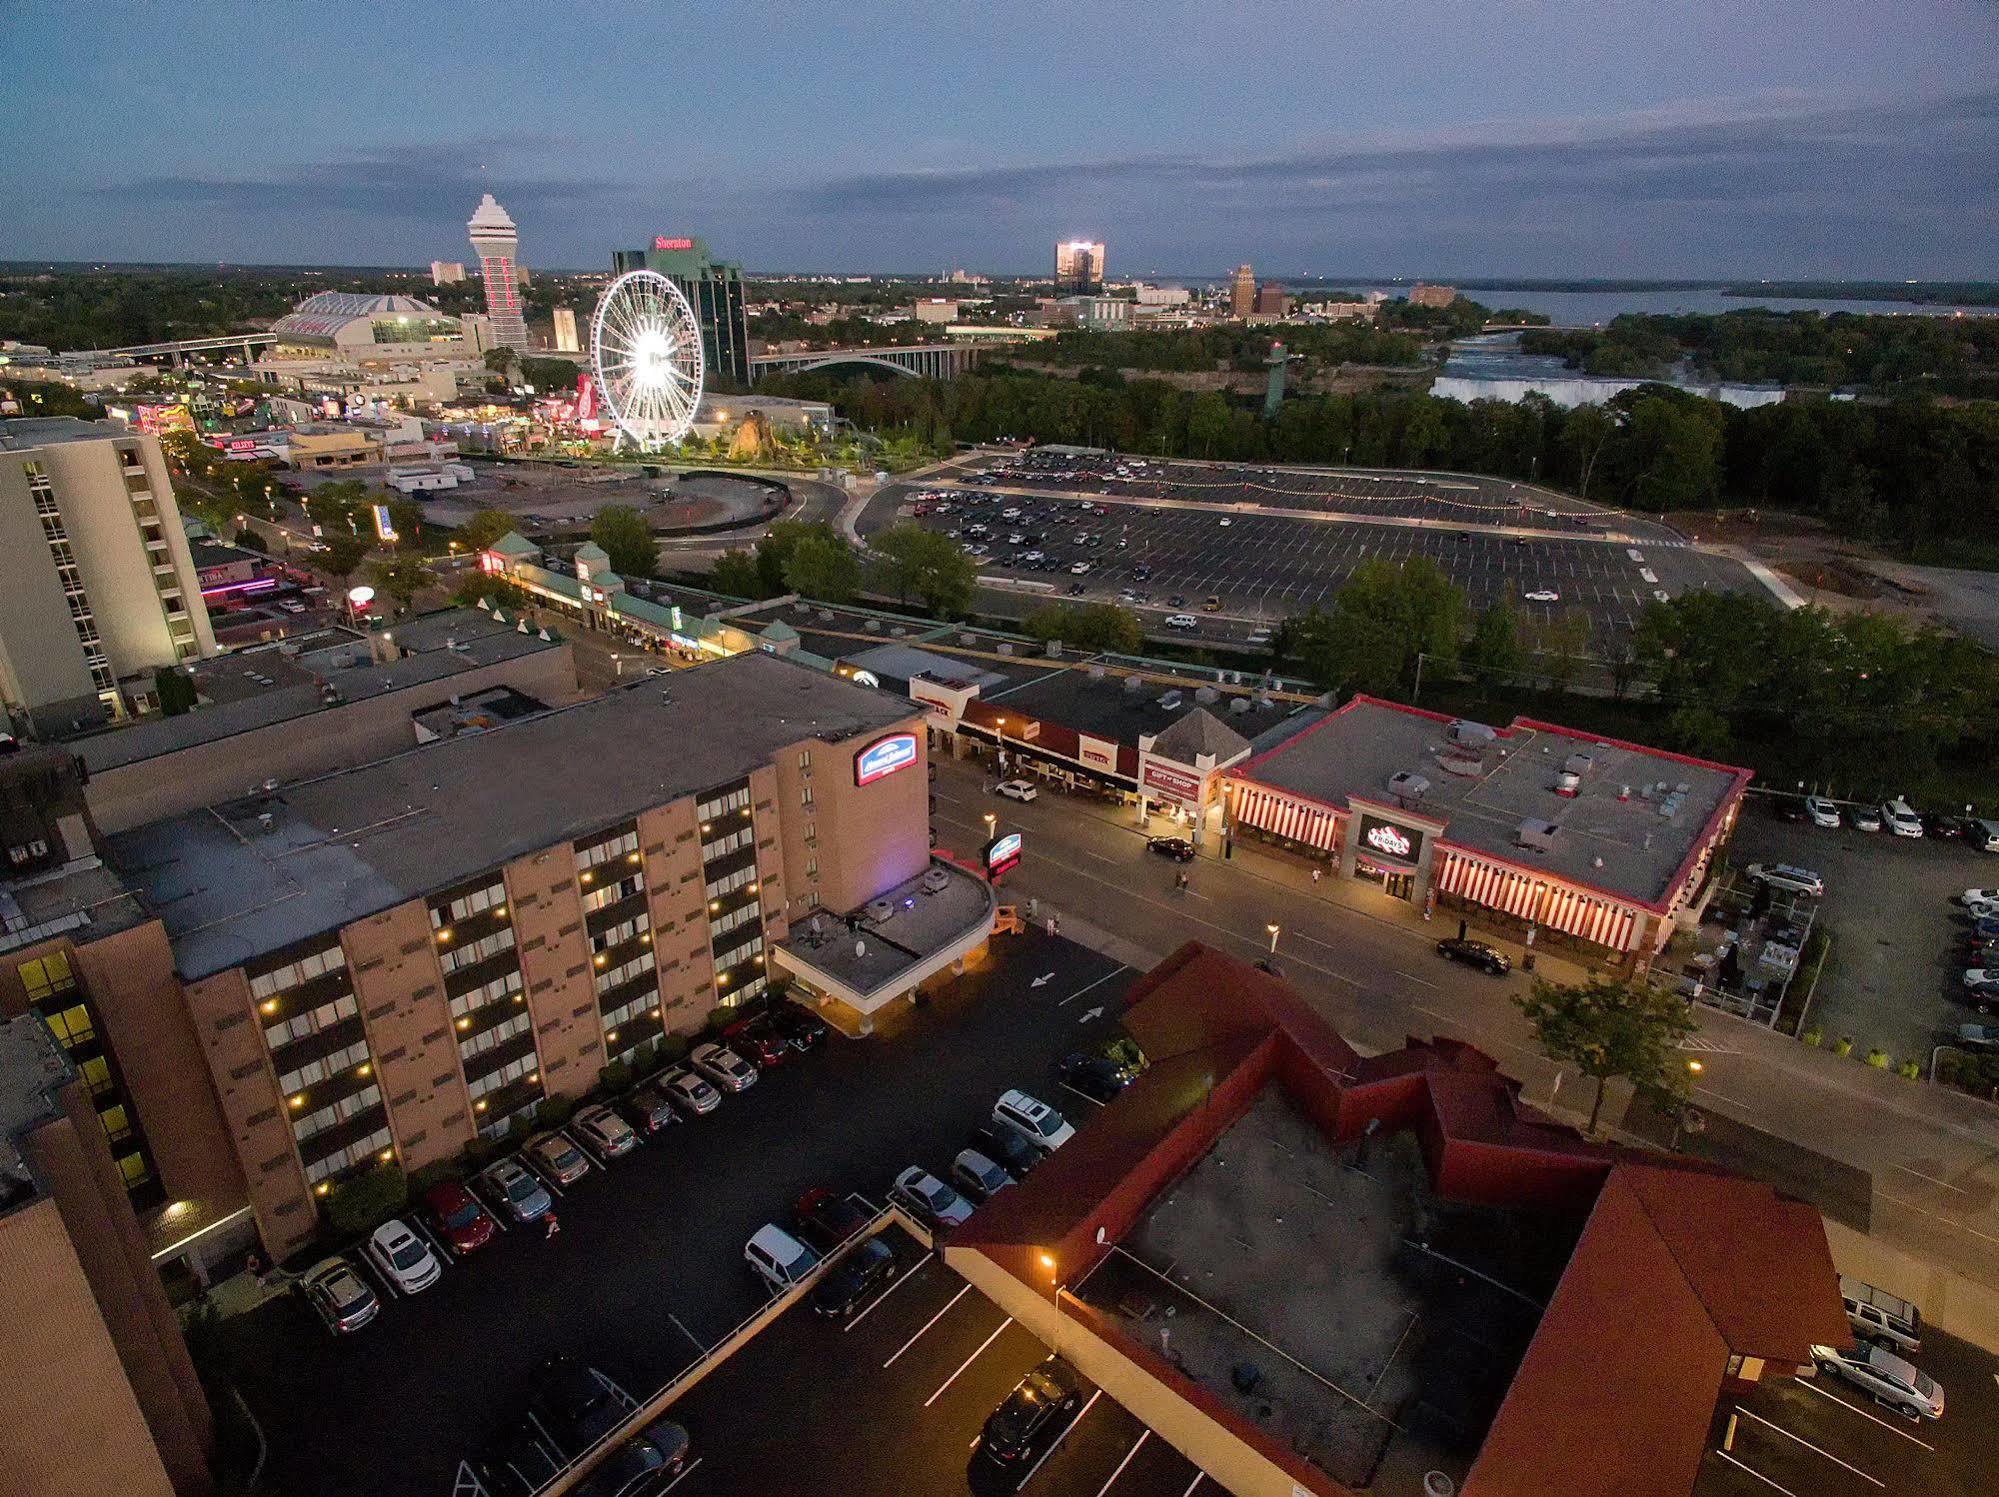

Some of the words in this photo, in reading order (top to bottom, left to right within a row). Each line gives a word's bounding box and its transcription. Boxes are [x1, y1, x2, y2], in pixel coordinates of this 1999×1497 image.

[656, 236, 692, 249] Sheraton
[231, 440, 255, 449] KELSEYS
[1151, 770, 1167, 780] GIFT
[1172, 777, 1192, 788] SHOP
